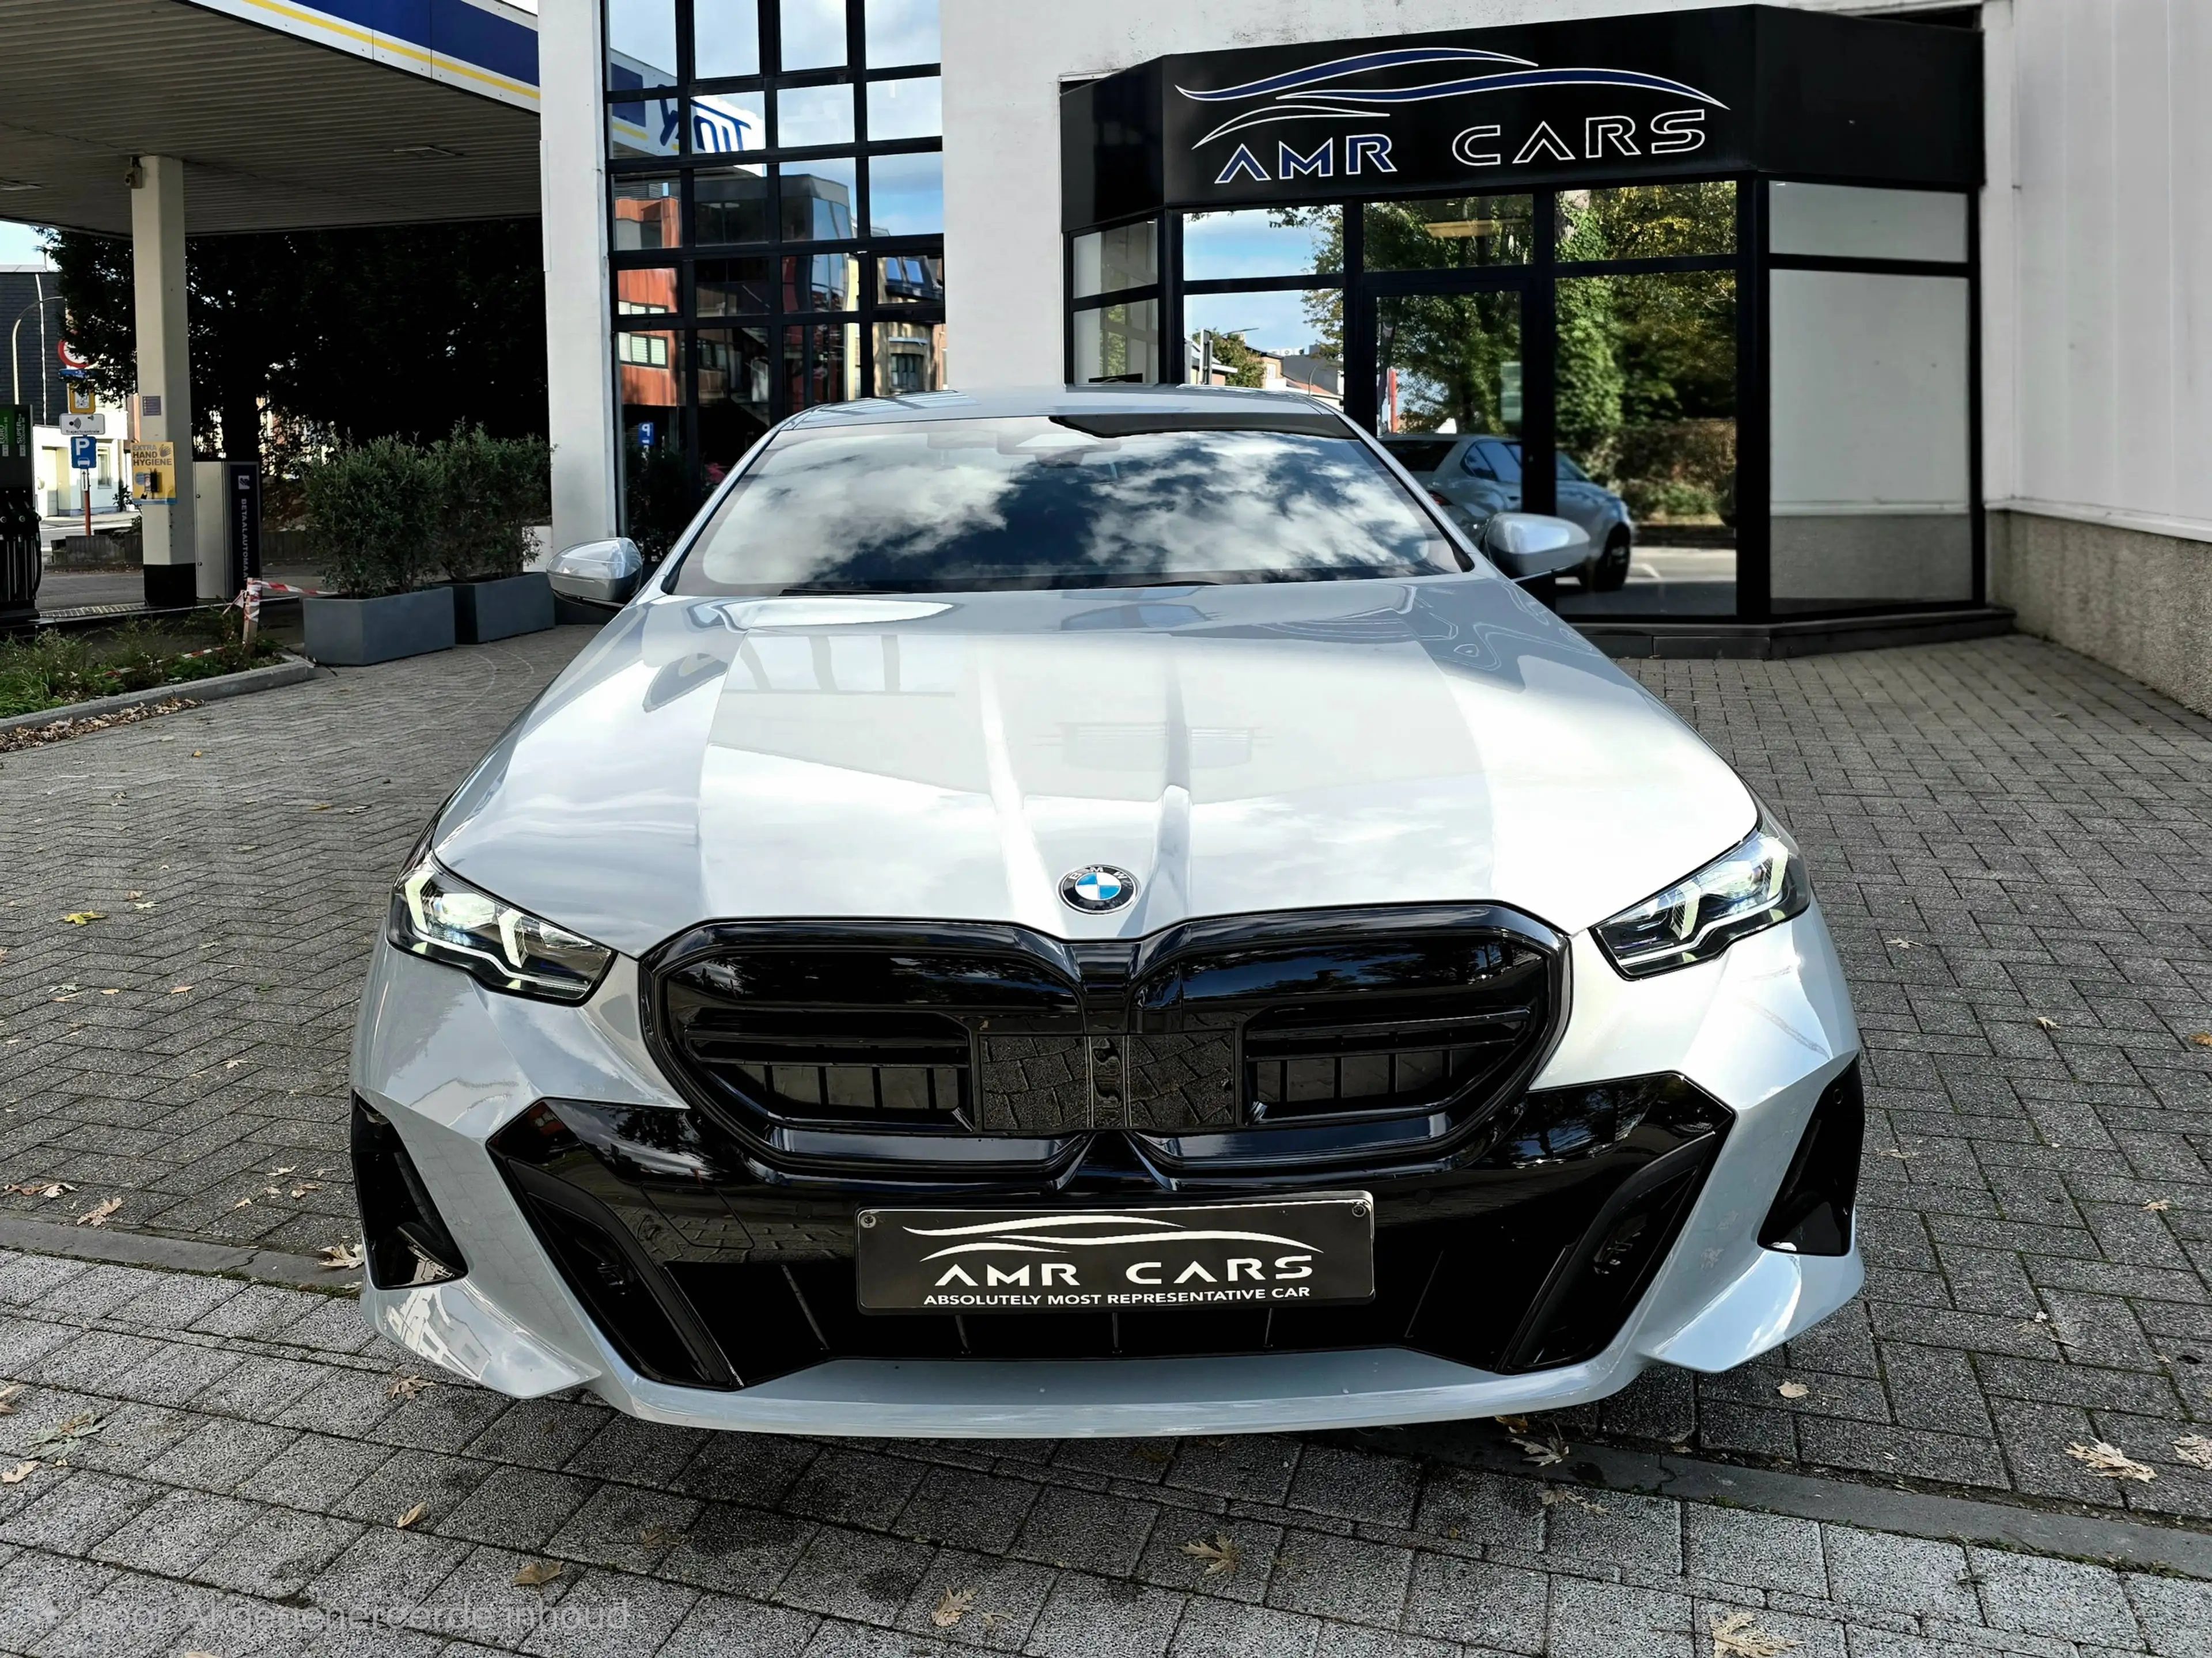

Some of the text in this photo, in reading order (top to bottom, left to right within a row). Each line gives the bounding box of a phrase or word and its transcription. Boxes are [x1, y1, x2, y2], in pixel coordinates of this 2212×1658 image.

[1214, 109, 1706, 184] AMR CARS
[75, 438, 90, 456] P
[1068, 867, 1128, 880] BMW
[934, 1255, 1313, 1286] AMR CARS
[923, 1287, 1310, 1305] ABSOLUTELY MOST REPRESENTATIVE CAR
